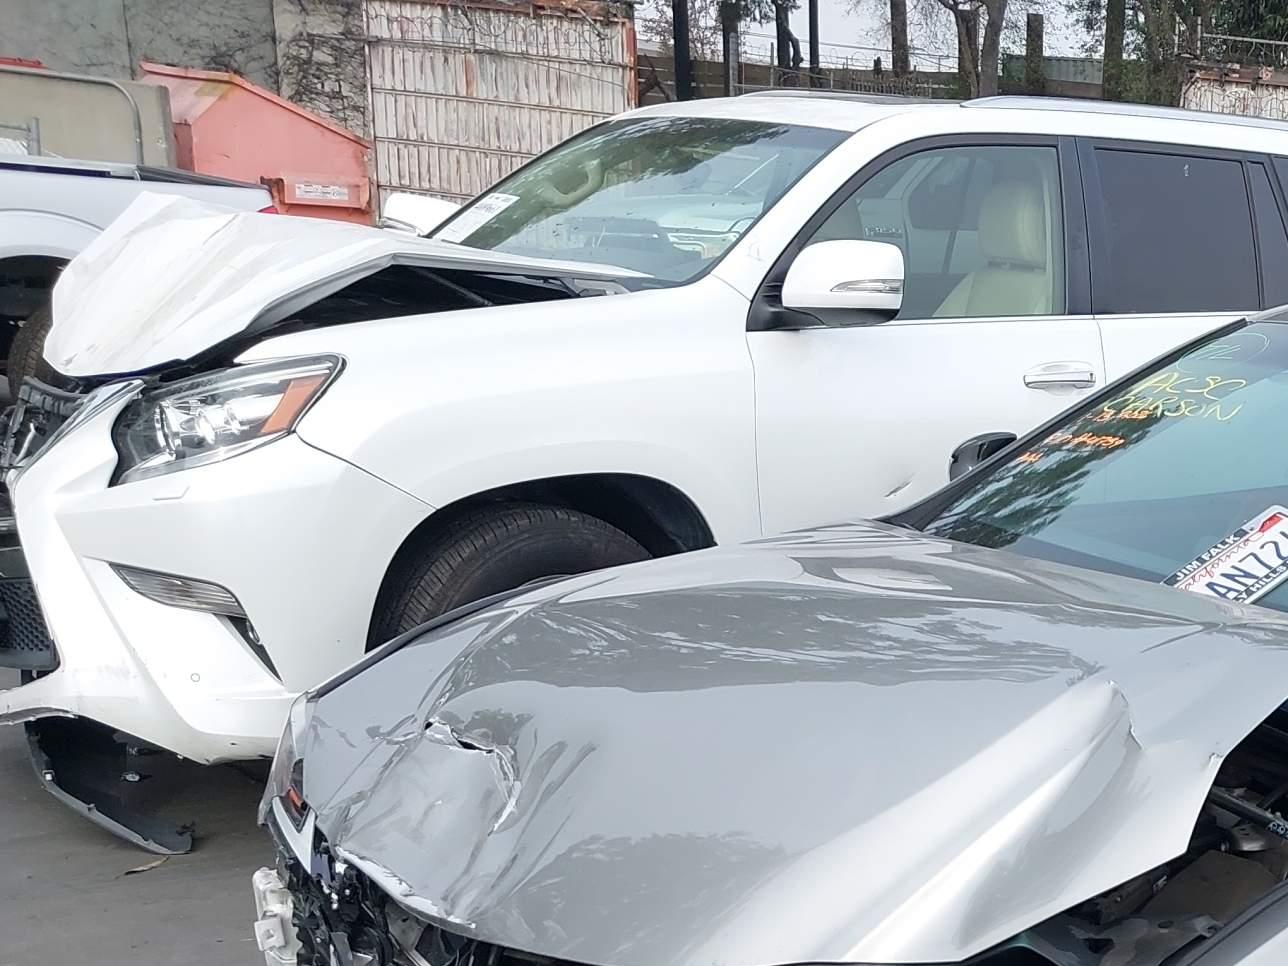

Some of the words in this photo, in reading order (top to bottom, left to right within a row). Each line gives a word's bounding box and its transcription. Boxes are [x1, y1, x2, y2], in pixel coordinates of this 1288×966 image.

[1103, 396, 1244, 421] CARSON
[1174, 561, 1202, 581] JIM
[1205, 534, 1241, 562] FALK
[1252, 564, 1288, 593] HILLS
